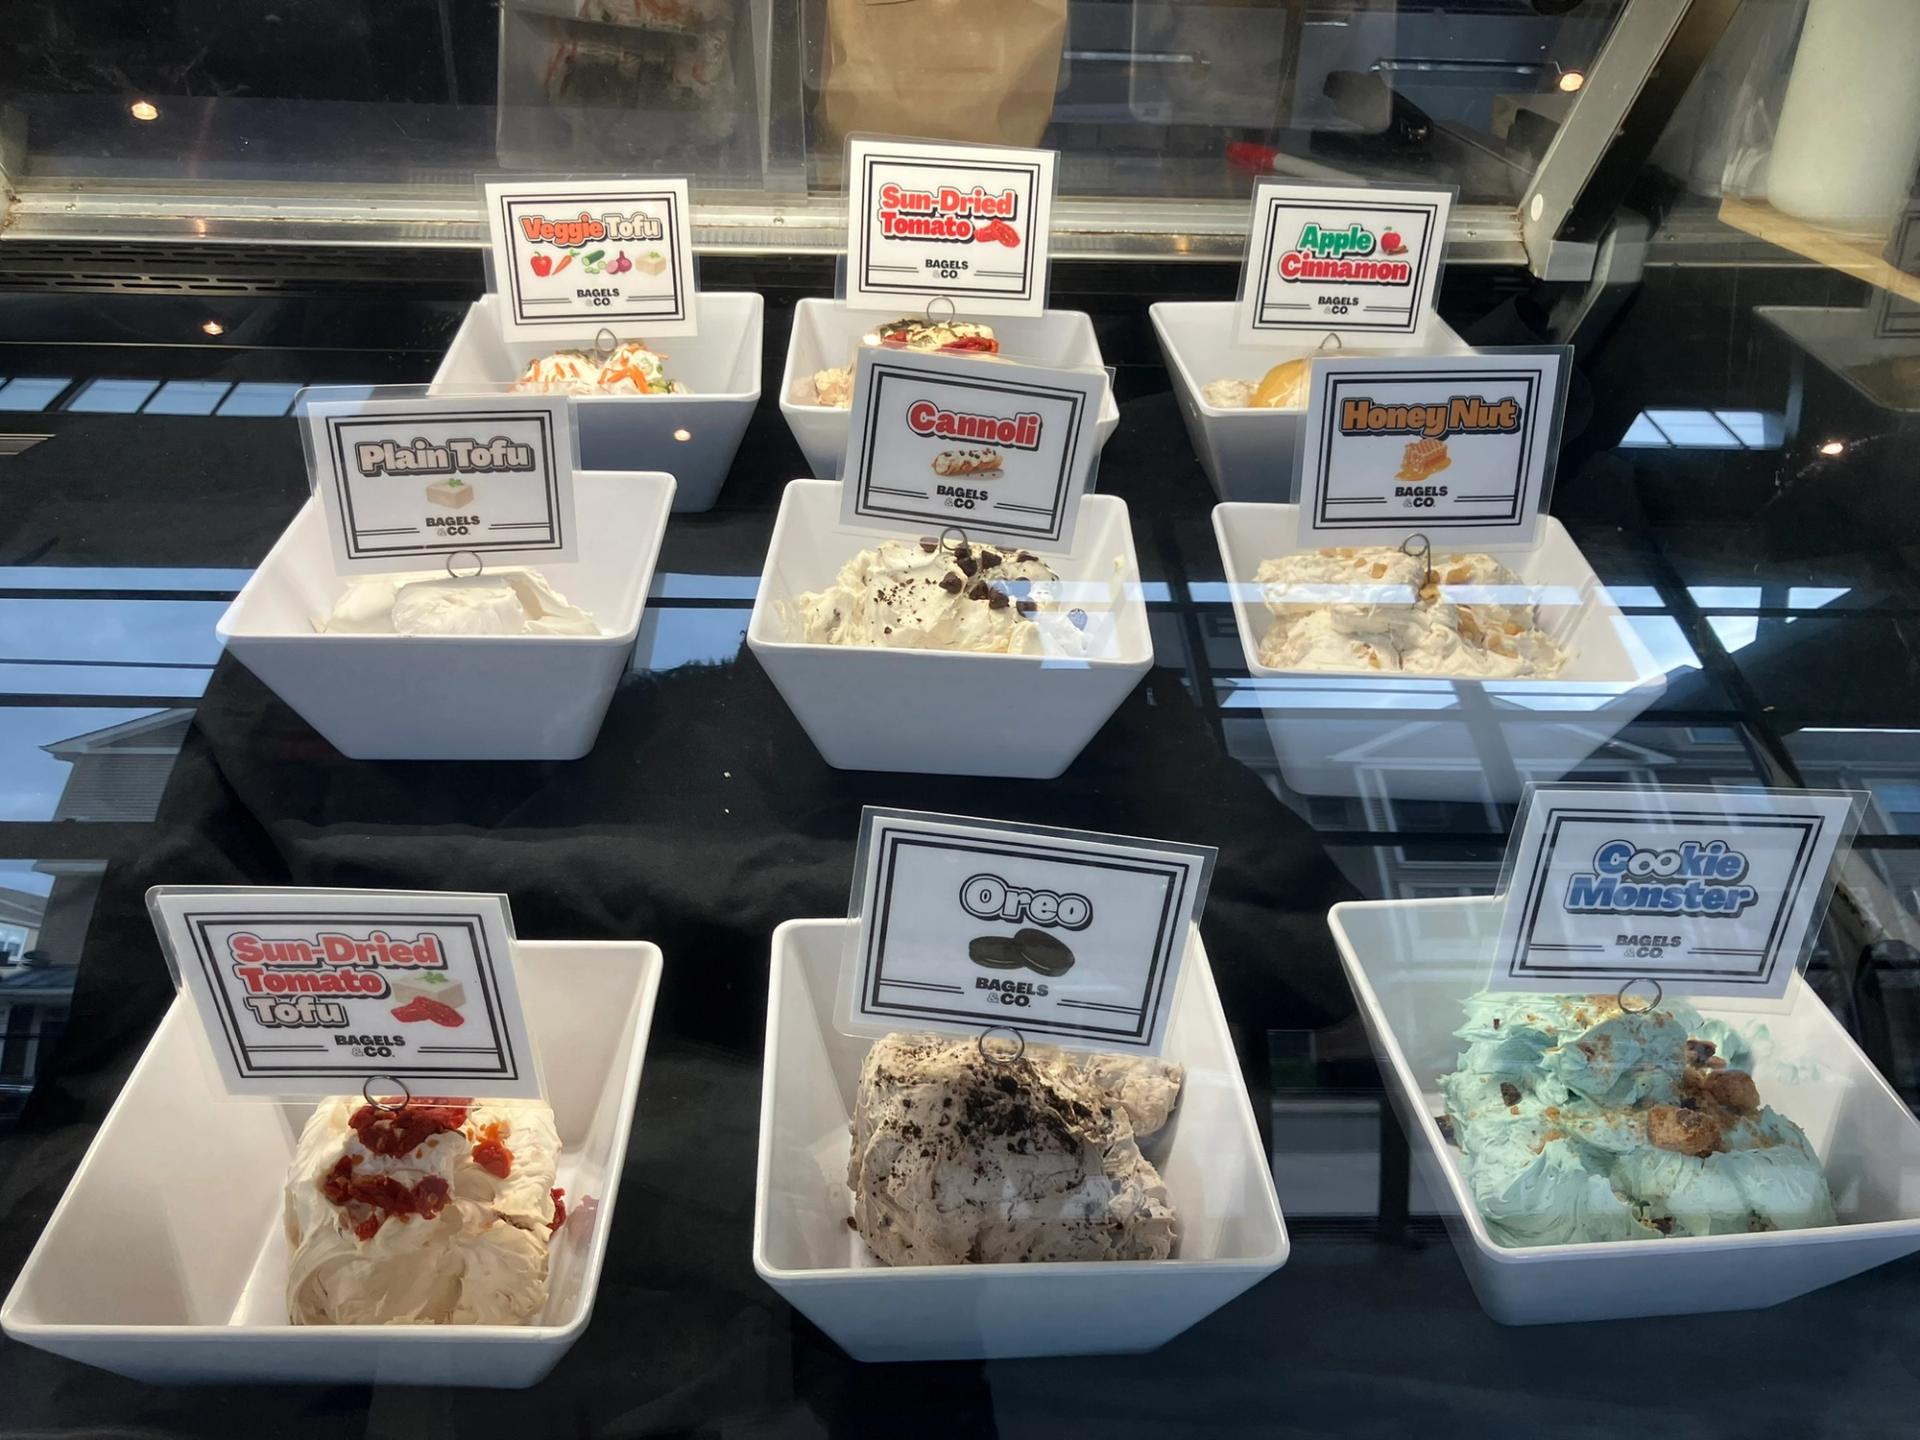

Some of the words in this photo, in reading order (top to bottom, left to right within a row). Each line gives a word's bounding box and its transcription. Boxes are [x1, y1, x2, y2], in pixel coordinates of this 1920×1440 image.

[880, 183, 1018, 221] Sun-Dried
[519, 212, 606, 248] Veggie
[601, 212, 662, 241] Tofu
[879, 211, 979, 244] Tomato
[1296, 223, 1376, 257] Apple
[924, 259, 968, 270] BAGELS
[1278, 250, 1412, 286] Cinnamon
[576, 288, 620, 298] BAGELS
[1318, 296, 1359, 306] BAGELS
[906, 400, 1043, 452] Cannoli
[1339, 397, 1450, 440] Honey
[1447, 396, 1522, 436] Nut
[354, 437, 456, 477] Plain
[446, 436, 535, 473] Tofu
[937, 485, 989, 501] BAGELS
[1395, 486, 1448, 497] BAGELS
[425, 516, 480, 527] BAGELS
[1593, 839, 1750, 883] Cookie
[960, 873, 1094, 932] Oreo
[1563, 872, 1759, 919] Monster
[227, 930, 448, 971] Sun-Dried
[1615, 934, 1682, 947] BAGELS
[232, 963, 391, 1000] Tomato
[975, 977, 1049, 998] BAGELS
[243, 995, 350, 1029] Tofu
[987, 992, 1032, 1008] &CO.
[334, 1034, 406, 1047] BAGELS
[352, 1046, 396, 1058] &CO.
